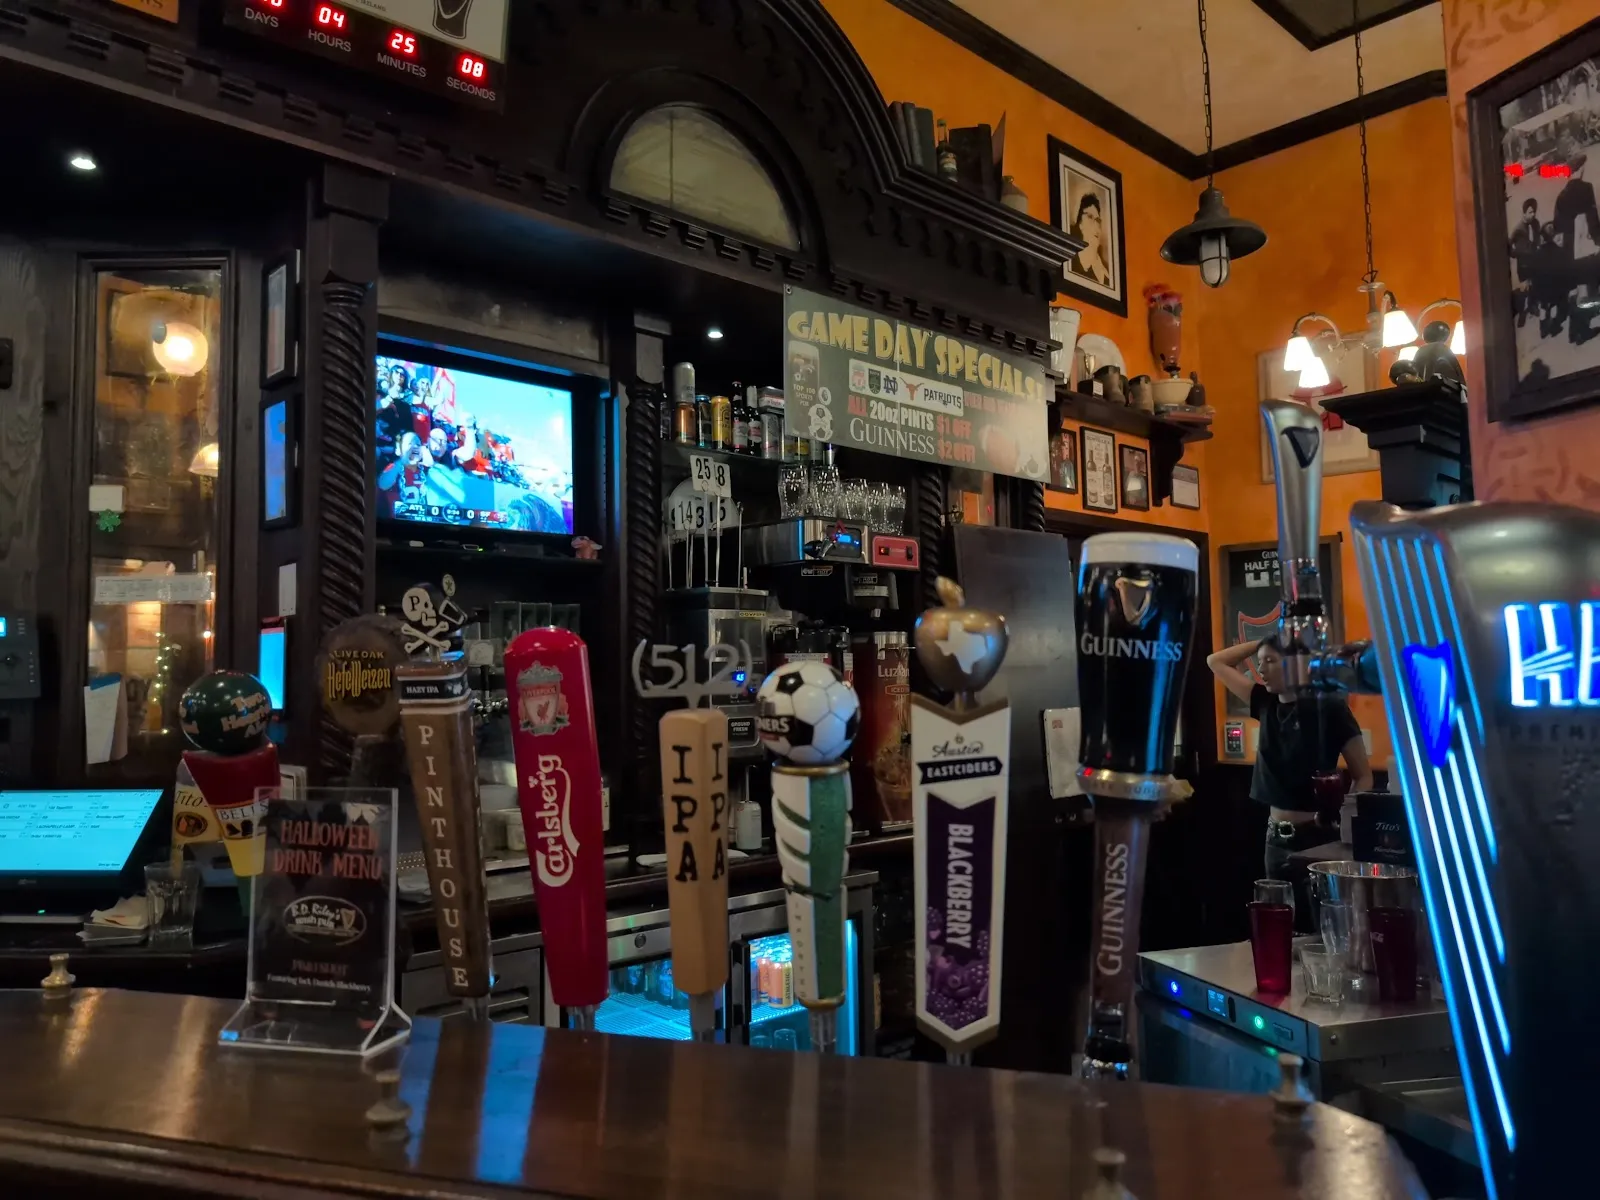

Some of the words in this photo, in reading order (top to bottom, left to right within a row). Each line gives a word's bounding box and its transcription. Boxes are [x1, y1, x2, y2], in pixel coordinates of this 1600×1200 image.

[244, 7, 279, 28] DAYS
[308, 29, 351, 52] HOURS
[377, 52, 427, 78] MINUTES
[446, 76, 496, 101] SECONDS
[318, 6, 345, 28] 04
[391, 32, 416, 54] 25
[461, 57, 485, 78] 08
[787, 310, 869, 355] GAME
[873, 318, 929, 369] DAY
[923, 387, 962, 409] PATRIOTS
[869, 399, 899, 424] 20oz
[900, 406, 935, 432] PINTS
[849, 416, 936, 456] GUINNESS
[695, 457, 711, 480] 25
[408, 503, 425, 512] ATL
[431, 506, 440, 516] 0
[466, 509, 475, 520] 0
[678, 500, 693, 524] 14
[1244, 560, 1270, 571] HALF
[408, 595, 420, 612] P
[334, 650, 359, 660] LIVE
[361, 650, 385, 660] OAK
[1080, 632, 1184, 662] GUINNESS
[632, 638, 753, 698] (512)
[406, 686, 427, 695] HAZY
[427, 686, 440, 694] IPA
[522, 685, 557, 698] LIVERPOOL
[932, 740, 984, 758] Austin
[926, 760, 997, 779] EASTCIDERS
[535, 754, 580, 888] Carlsberg
[671, 744, 699, 882] IPA
[710, 741, 726, 881] IPA
[1375, 821, 1401, 832] Tito's
[280, 819, 380, 851] HALLOWEEN
[272, 847, 324, 877] DRINK
[332, 852, 383, 880] MENU
[418, 724, 469, 987] PINTHOUSE
[945, 823, 975, 949] BLACKBERRY
[1096, 842, 1129, 976] GUINNESS
